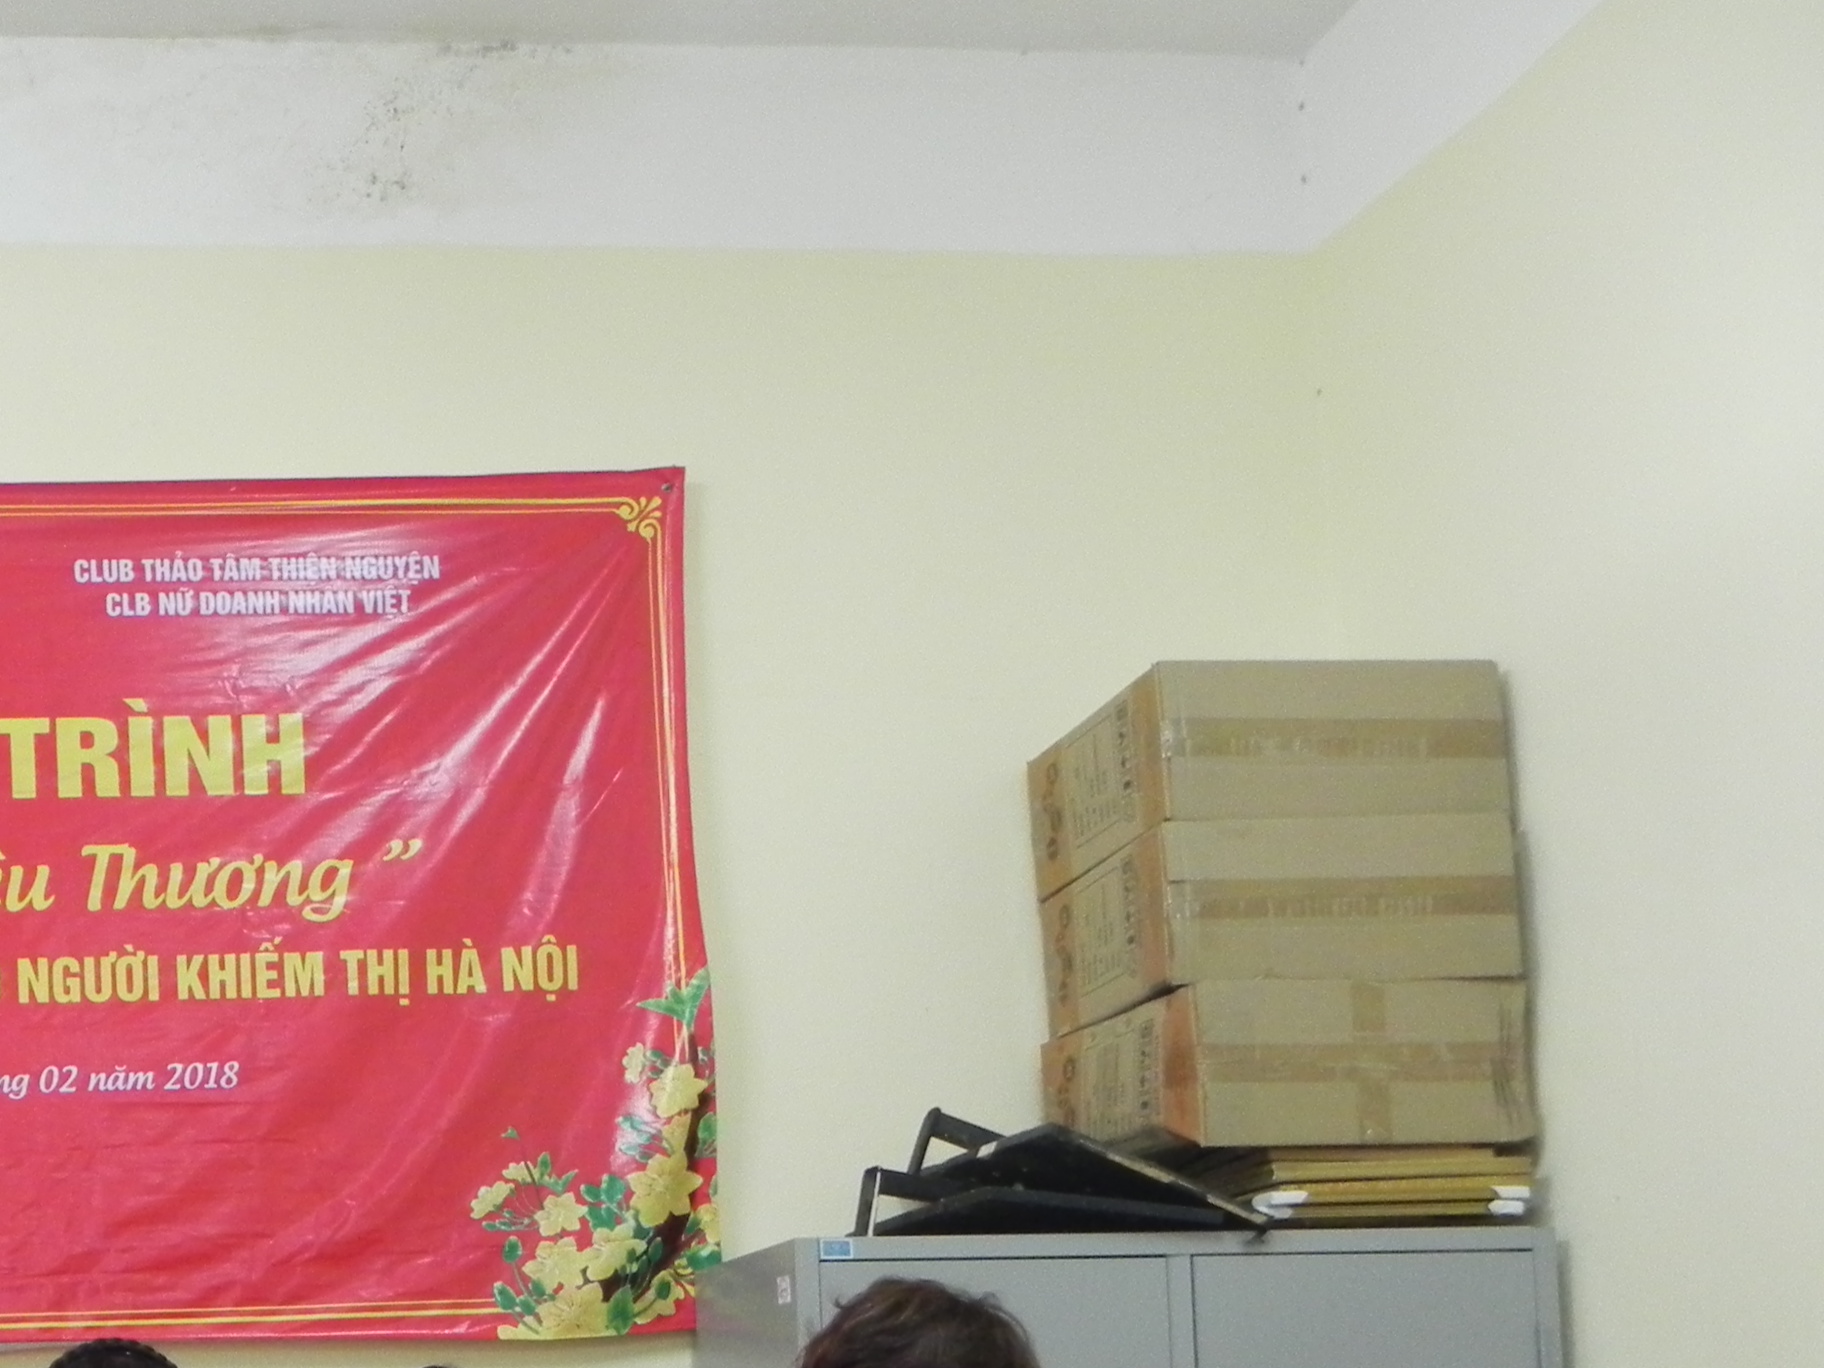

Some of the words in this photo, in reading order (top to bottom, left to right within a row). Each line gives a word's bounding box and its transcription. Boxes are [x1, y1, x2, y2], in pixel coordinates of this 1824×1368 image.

[73, 558, 134, 583] CLUB
[141, 551, 203, 582] THẢO
[209, 553, 262, 582] TÂM
[105, 592, 152, 617] CLB
[158, 587, 194, 617] NỮ
[199, 591, 284, 616] DOANH
[287, 587, 355, 615] NHÂN
[361, 586, 412, 620] VIỆT
[80, 842, 354, 923] Thương
[16, 945, 160, 1005] NGƯỜI
[176, 936, 326, 1001] KHIẾM
[340, 947, 411, 1007] THỊ
[425, 937, 487, 995] HÀ
[501, 935, 580, 1003] NỘI
[37, 1064, 78, 1095] 02
[87, 1063, 155, 1093] năm
[163, 1060, 240, 1091] 2018
